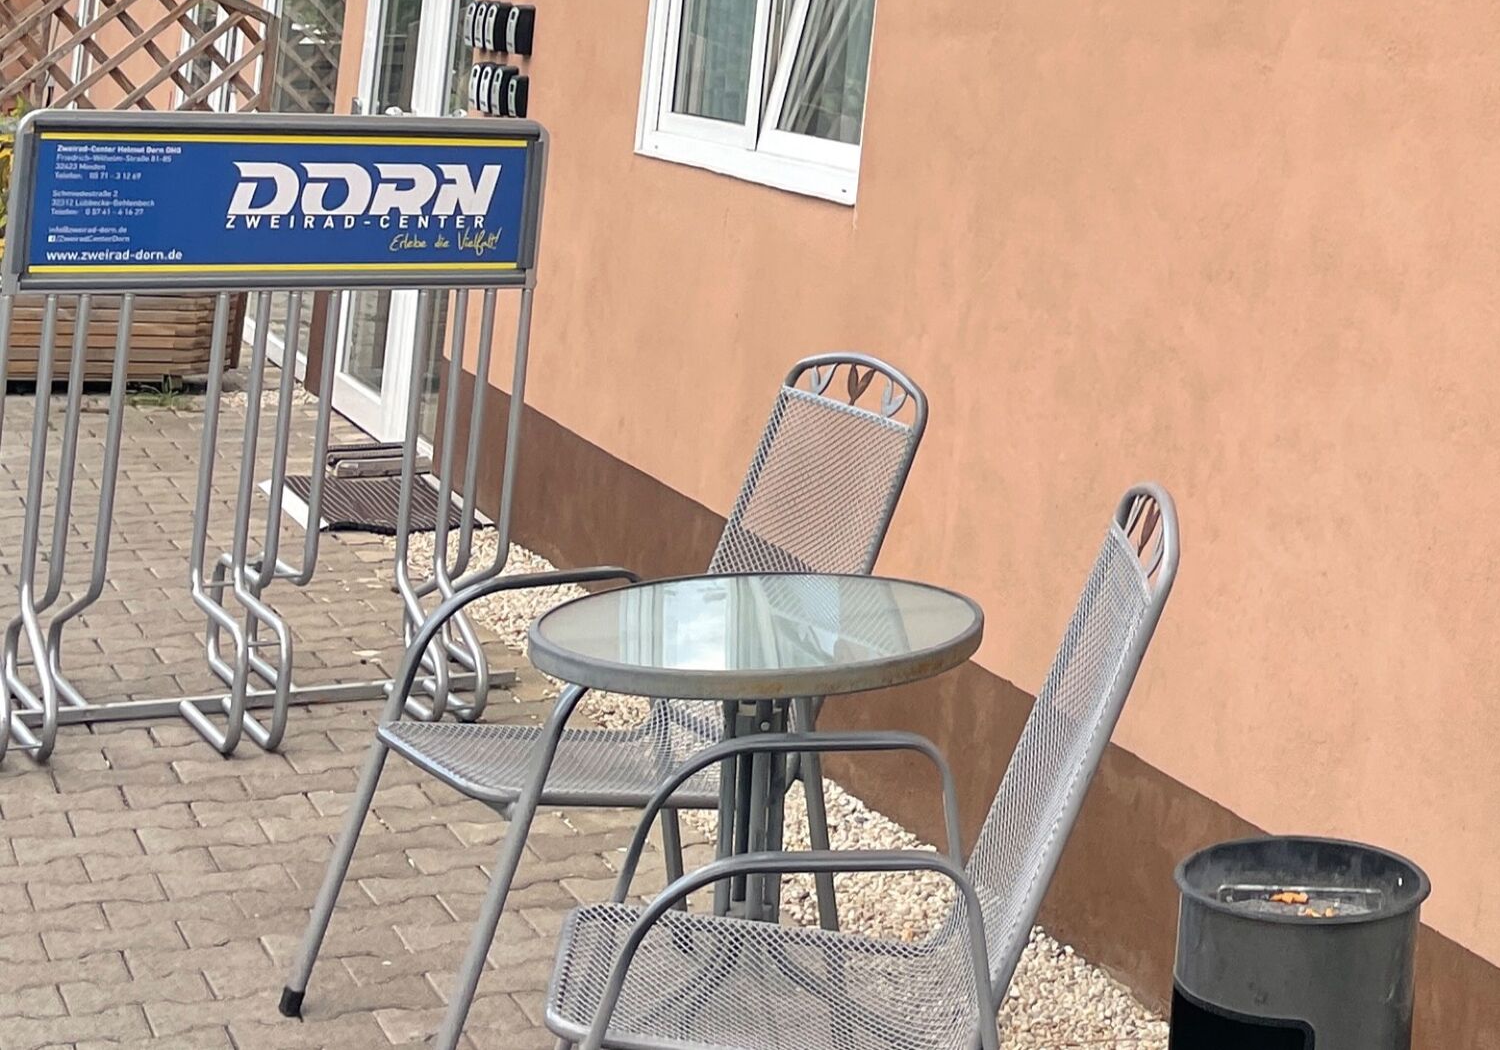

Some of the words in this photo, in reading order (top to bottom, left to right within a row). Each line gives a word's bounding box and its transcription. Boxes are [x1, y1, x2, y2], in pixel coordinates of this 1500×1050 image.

[146, 146, 164, 154] Dorn
[228, 161, 502, 216] DORN
[225, 215, 486, 229] ZWEIRAD-CENTER
[389, 233, 427, 252] Erlebe
[434, 235, 450, 249] die
[457, 227, 503, 256] Vielfalt!
[46, 248, 183, 261] www.zweirad-dorn.de
